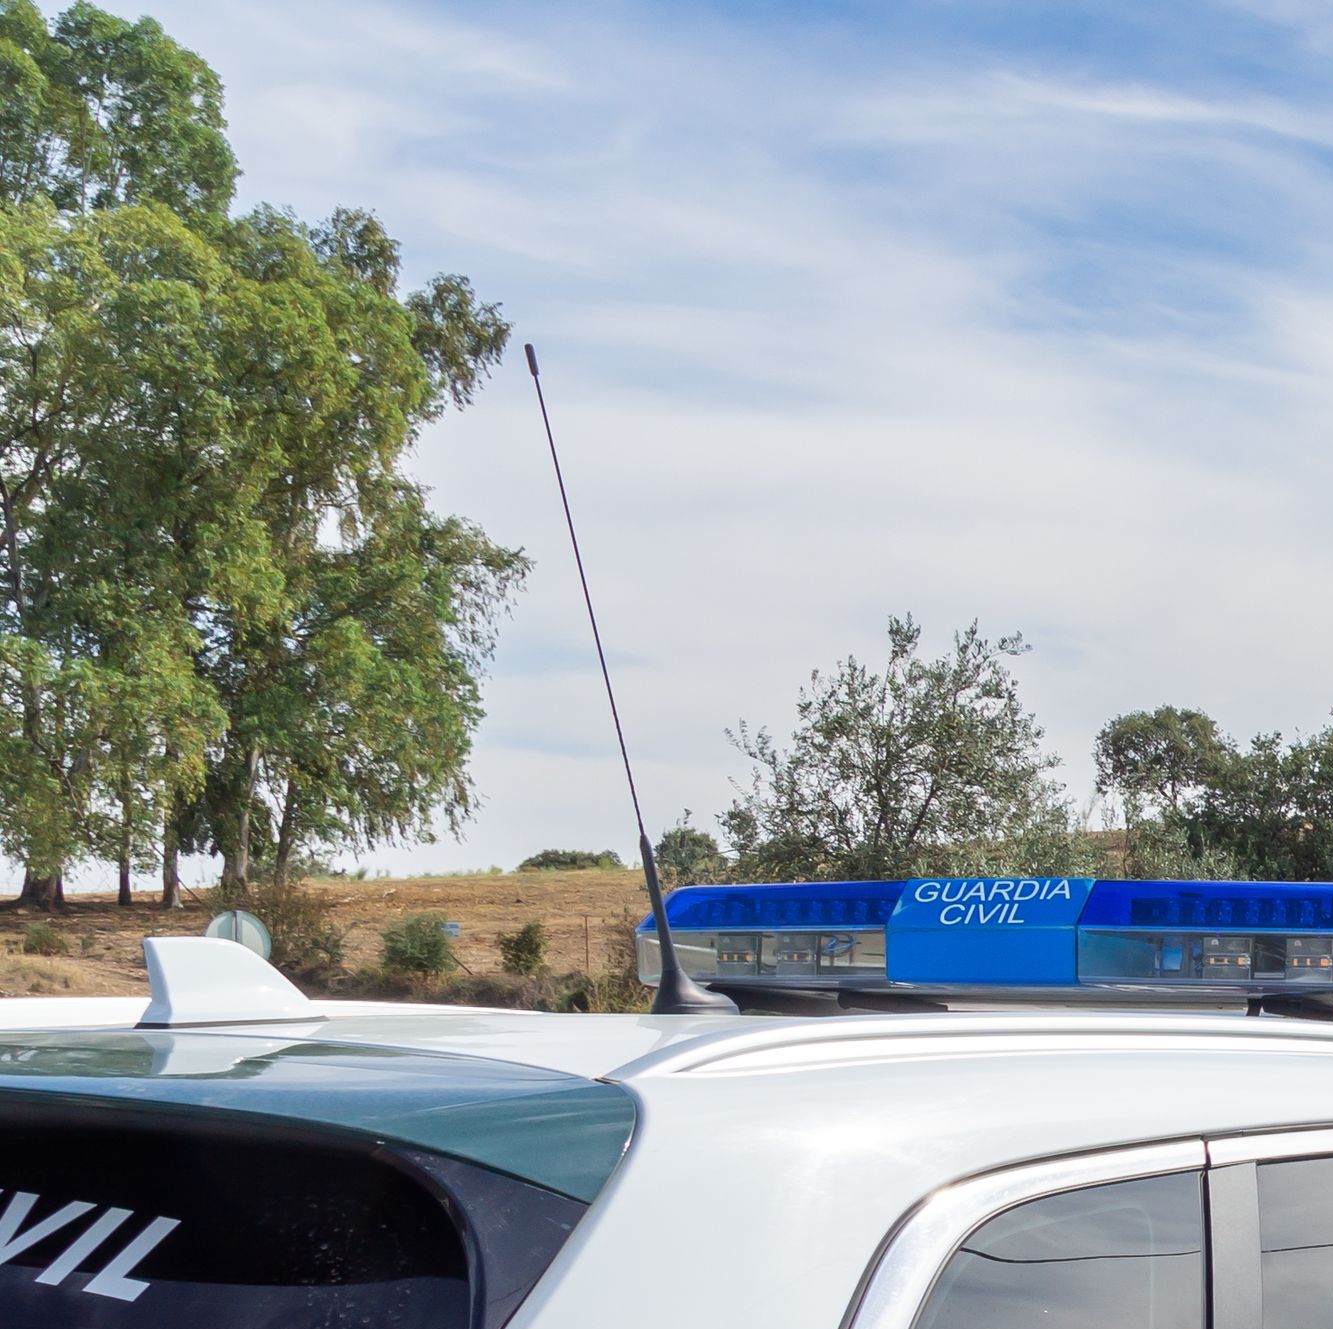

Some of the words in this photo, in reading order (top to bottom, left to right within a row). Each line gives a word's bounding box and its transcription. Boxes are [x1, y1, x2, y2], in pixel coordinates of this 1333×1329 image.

[915, 879, 1071, 903] GUARDIA
[939, 903, 1025, 925] CIVIL
[0, 1189, 183, 1303] VIL
